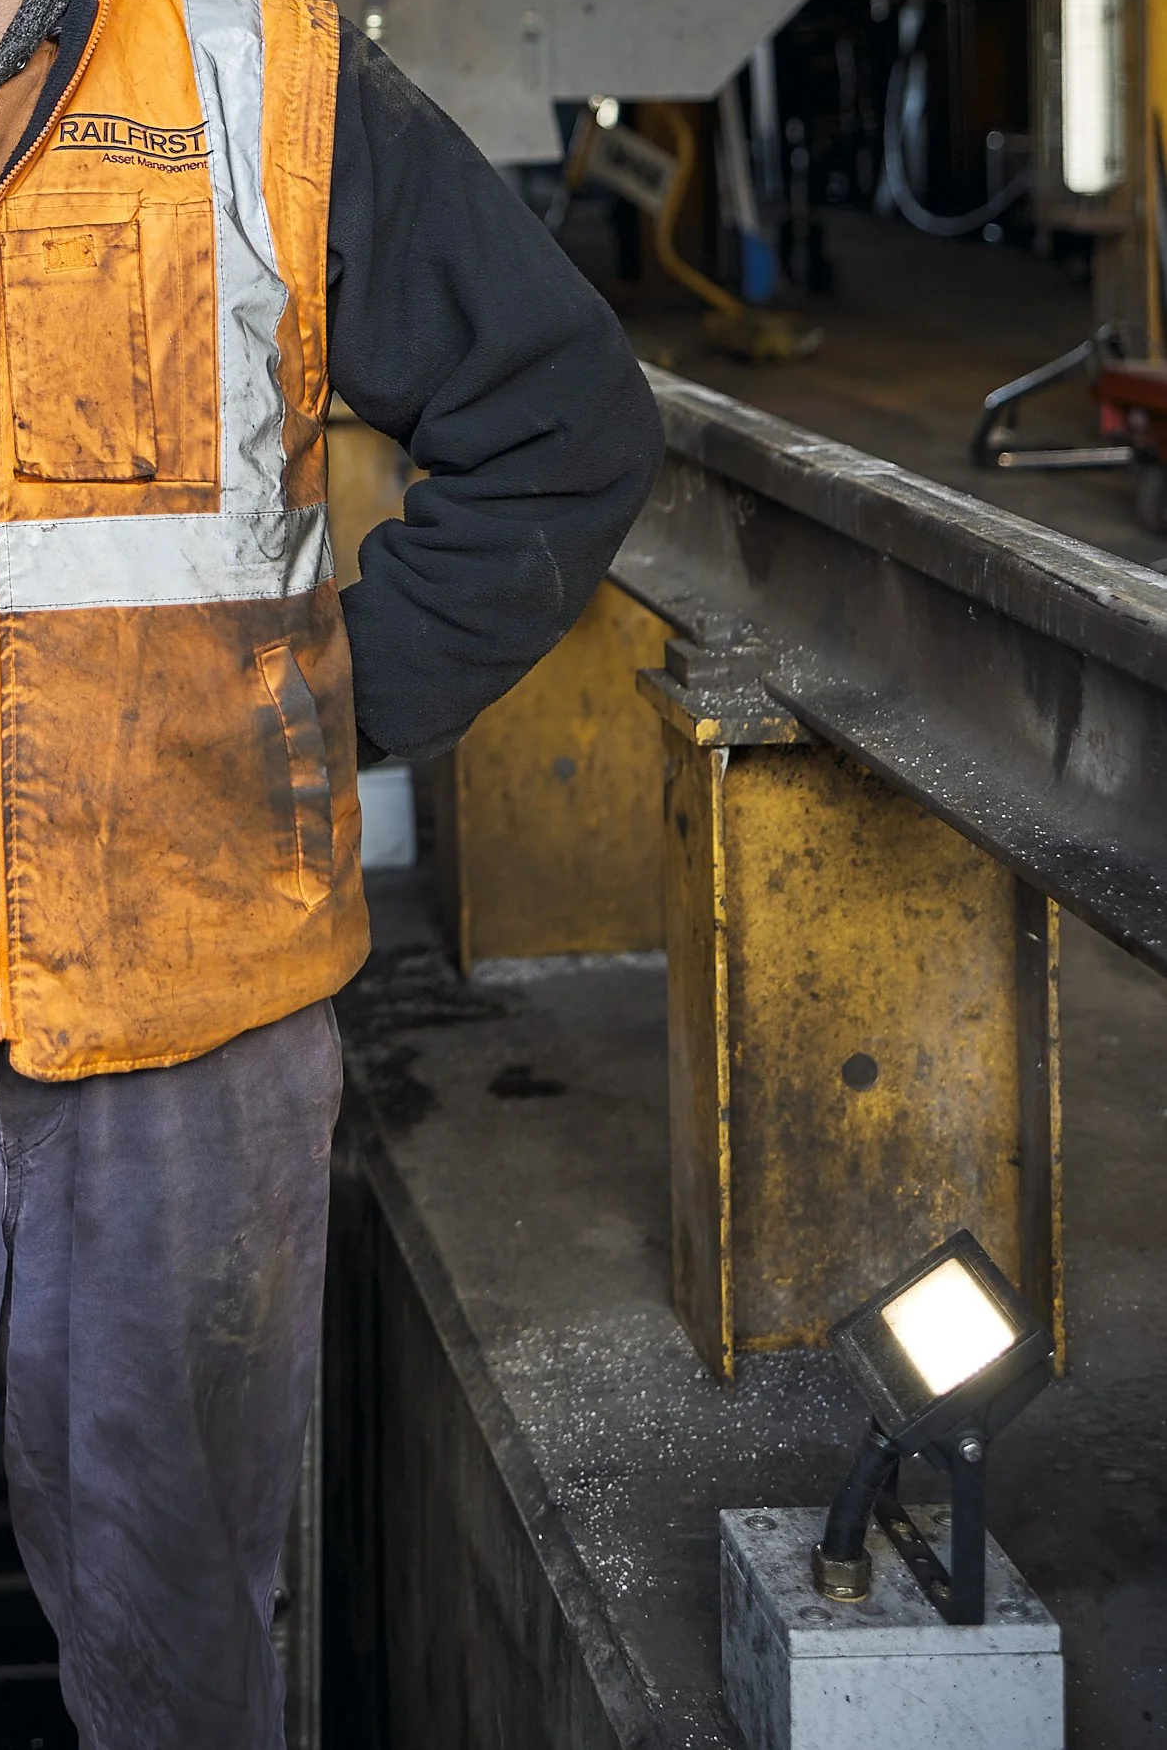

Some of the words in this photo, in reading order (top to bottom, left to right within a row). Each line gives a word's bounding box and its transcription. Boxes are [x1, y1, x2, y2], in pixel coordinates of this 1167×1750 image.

[60, 121, 205, 154] RAILFIRST
[102, 153, 135, 164] Asset
[138, 156, 208, 173] Management
